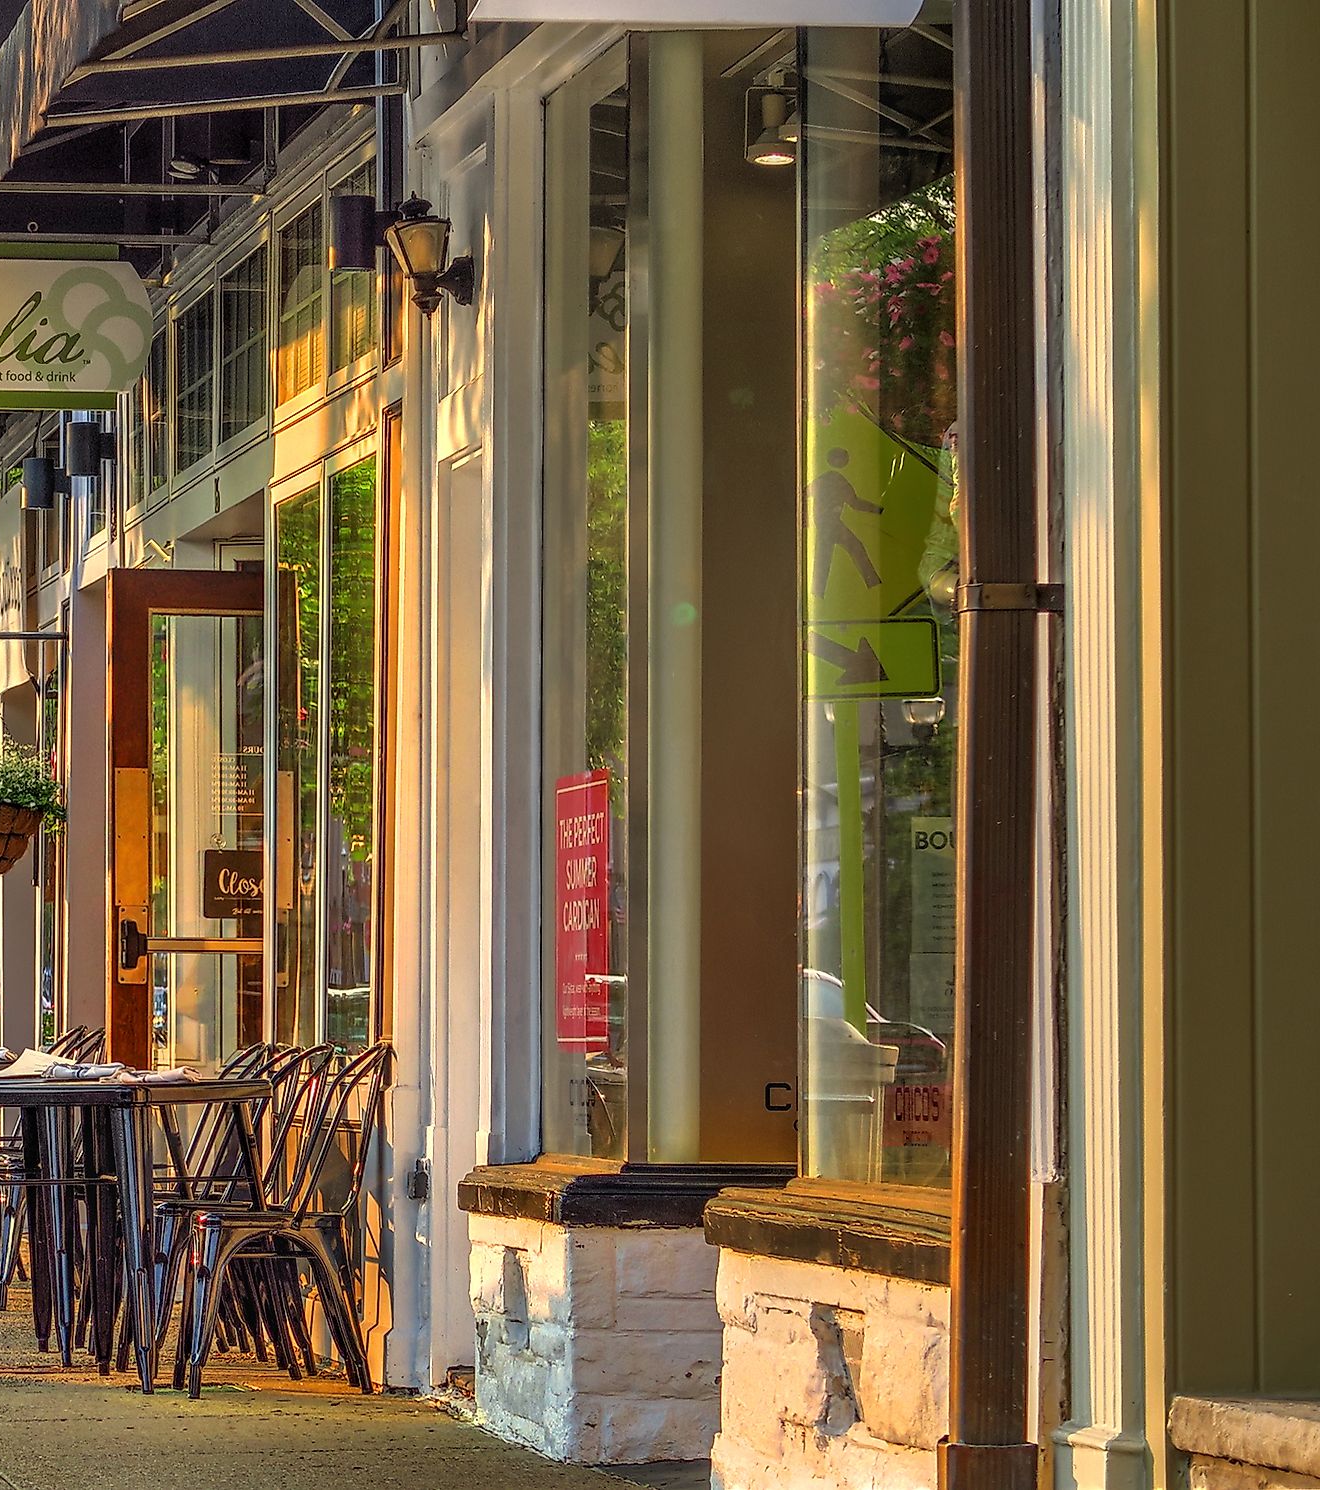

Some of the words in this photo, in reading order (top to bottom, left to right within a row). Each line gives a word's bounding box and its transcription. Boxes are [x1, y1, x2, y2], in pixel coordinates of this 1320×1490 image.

[6, 370, 31, 382] food
[35, 371, 44, 382] &
[46, 371, 76, 382] drink
[559, 818, 573, 849] THE
[573, 812, 605, 848] PERFECT
[566, 856, 597, 890] SUMMER
[563, 898, 600, 932] CARDIGAN
